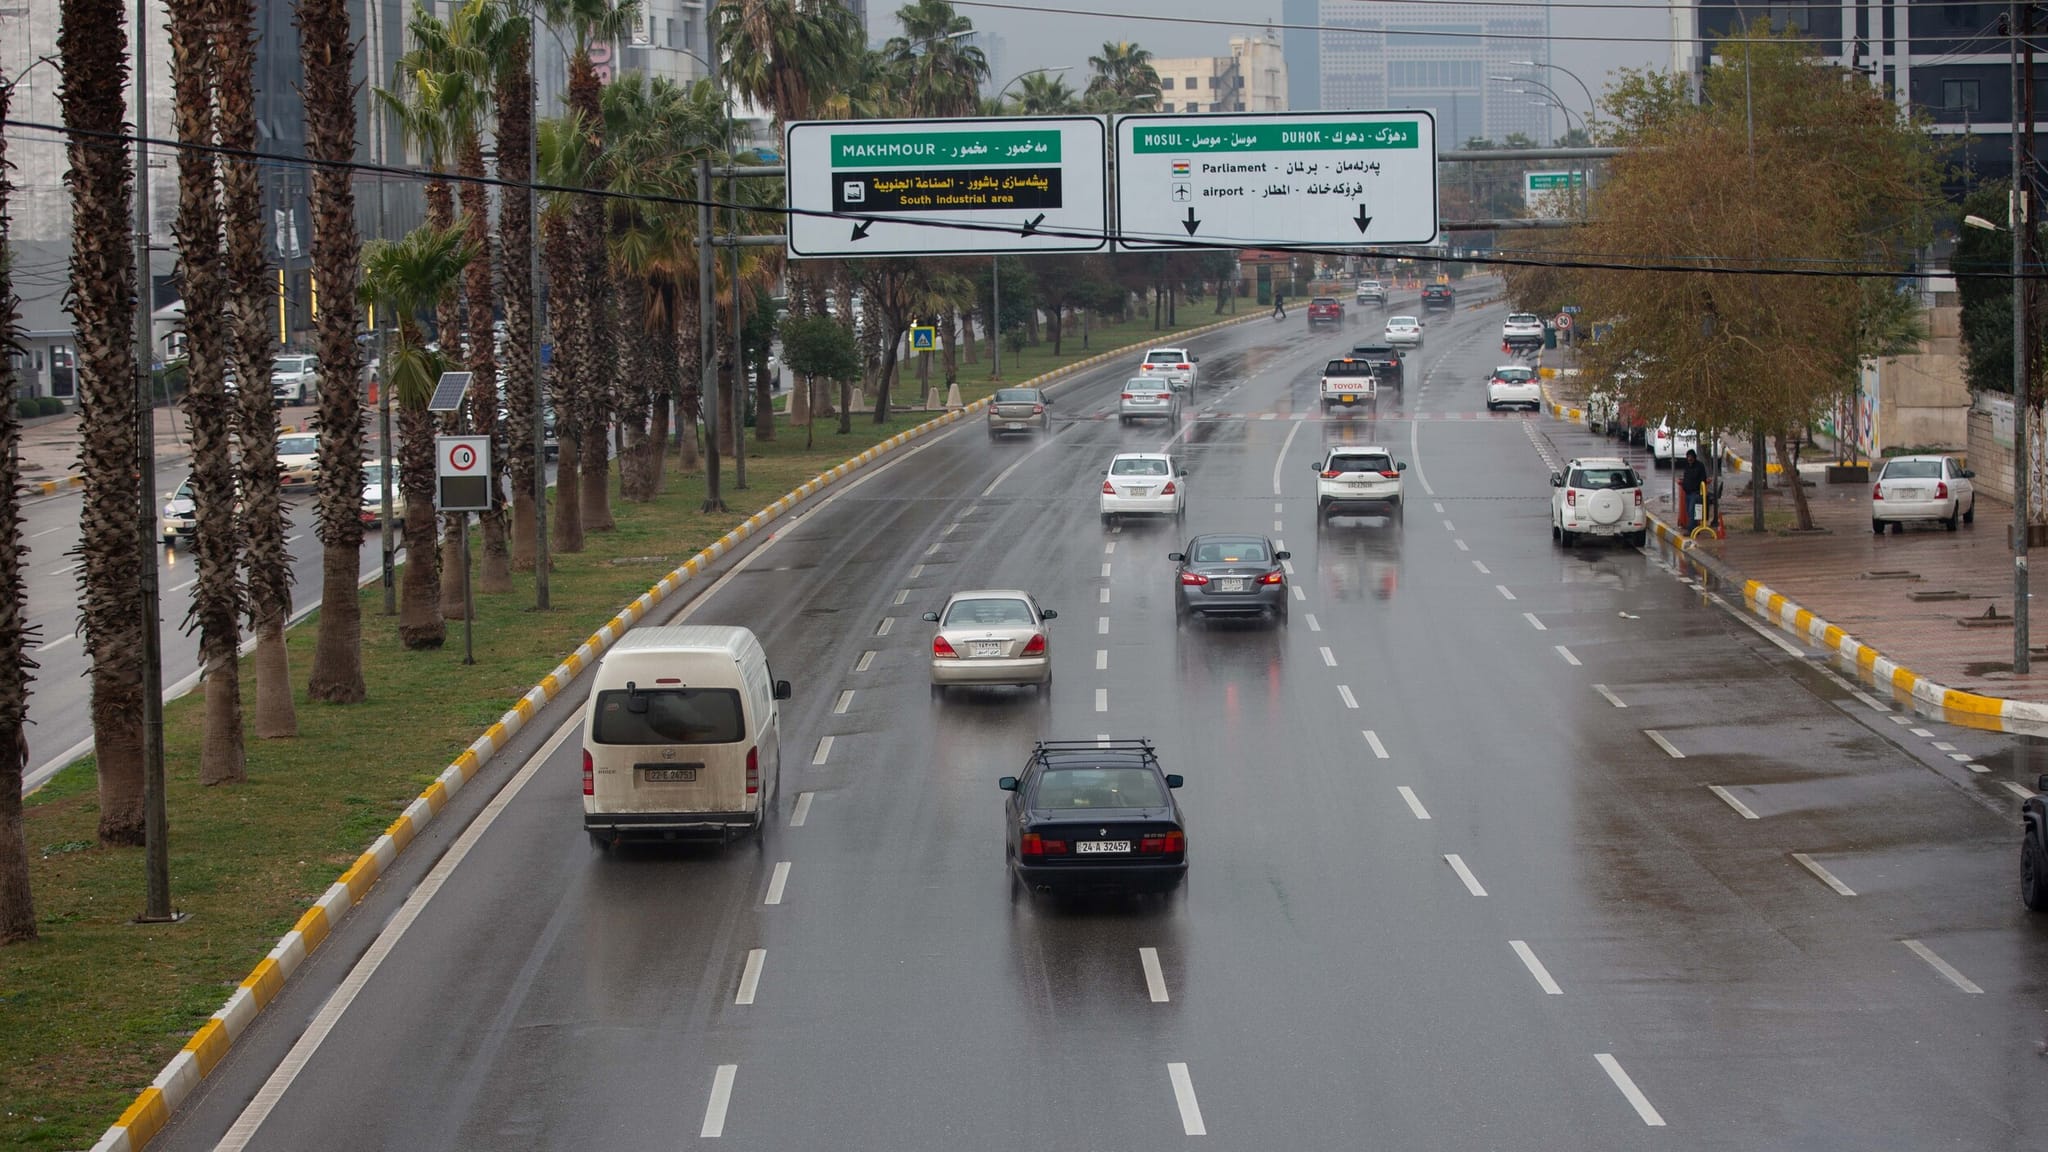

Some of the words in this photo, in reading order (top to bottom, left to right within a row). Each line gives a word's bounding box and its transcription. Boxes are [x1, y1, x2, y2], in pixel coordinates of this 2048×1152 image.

[1144, 134, 1182, 146] MOSUL
[1192, 134, 1221, 148] موصل
[1282, 131, 1321, 143] DUHOK
[842, 143, 936, 157] MAKHMOUR
[951, 141, 988, 158] مخمور
[1202, 163, 1267, 173] Parliament
[1286, 161, 1318, 175] برلمان
[873, 178, 913, 192] الجنوبية
[915, 177, 954, 189] الصناعة
[967, 175, 999, 191] باشوور
[1203, 186, 1244, 198] airport
[1262, 184, 1290, 198] المطار
[900, 195, 931, 205] South
[936, 194, 987, 204] industrial
[991, 194, 1014, 203] area
[1083, 843, 1092, 852] 24
[1095, 842, 1100, 851] A
[1103, 842, 1128, 852] 32457
